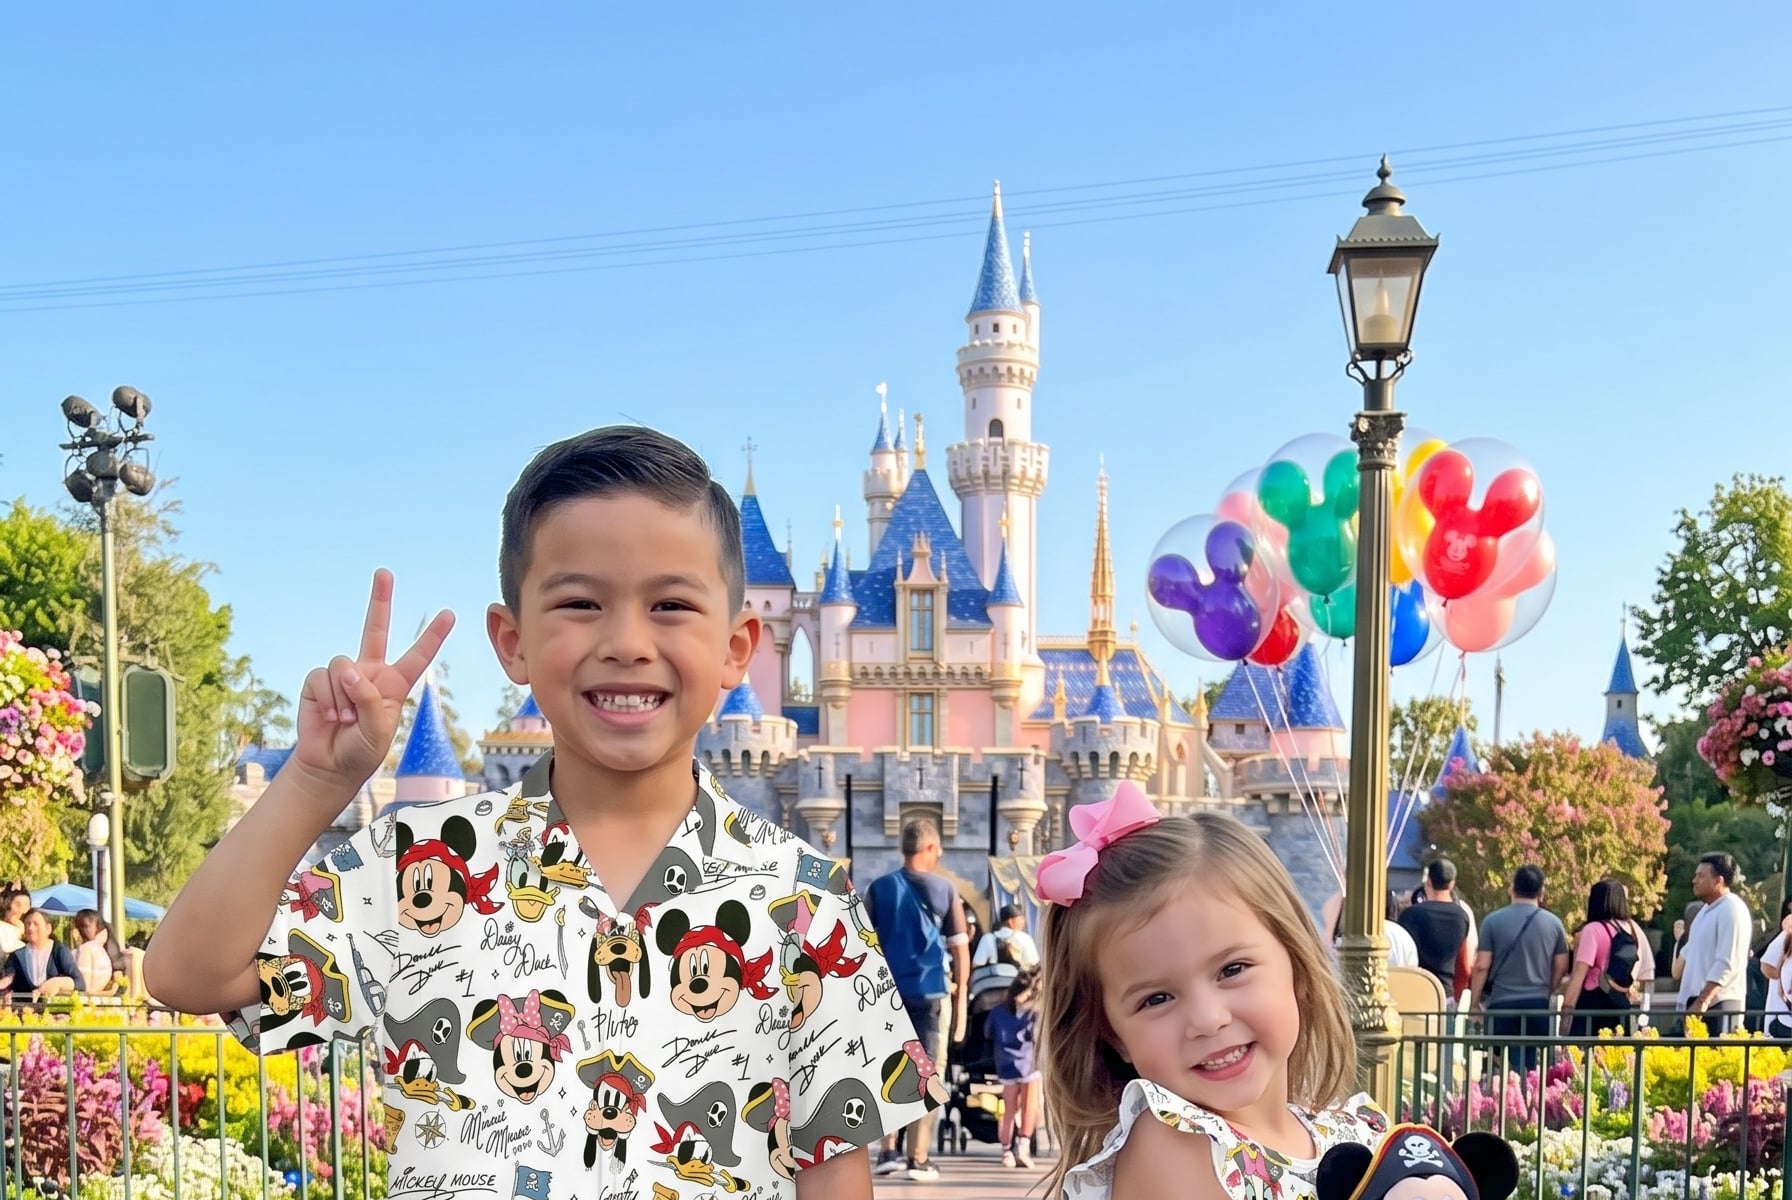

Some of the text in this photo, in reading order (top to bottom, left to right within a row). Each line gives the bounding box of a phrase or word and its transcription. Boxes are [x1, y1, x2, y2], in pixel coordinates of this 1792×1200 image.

[455, 969, 475, 997] #1
[844, 1036, 876, 1068] #1
[731, 1053, 751, 1081] #1
[450, 1173, 498, 1188] MOUSE
